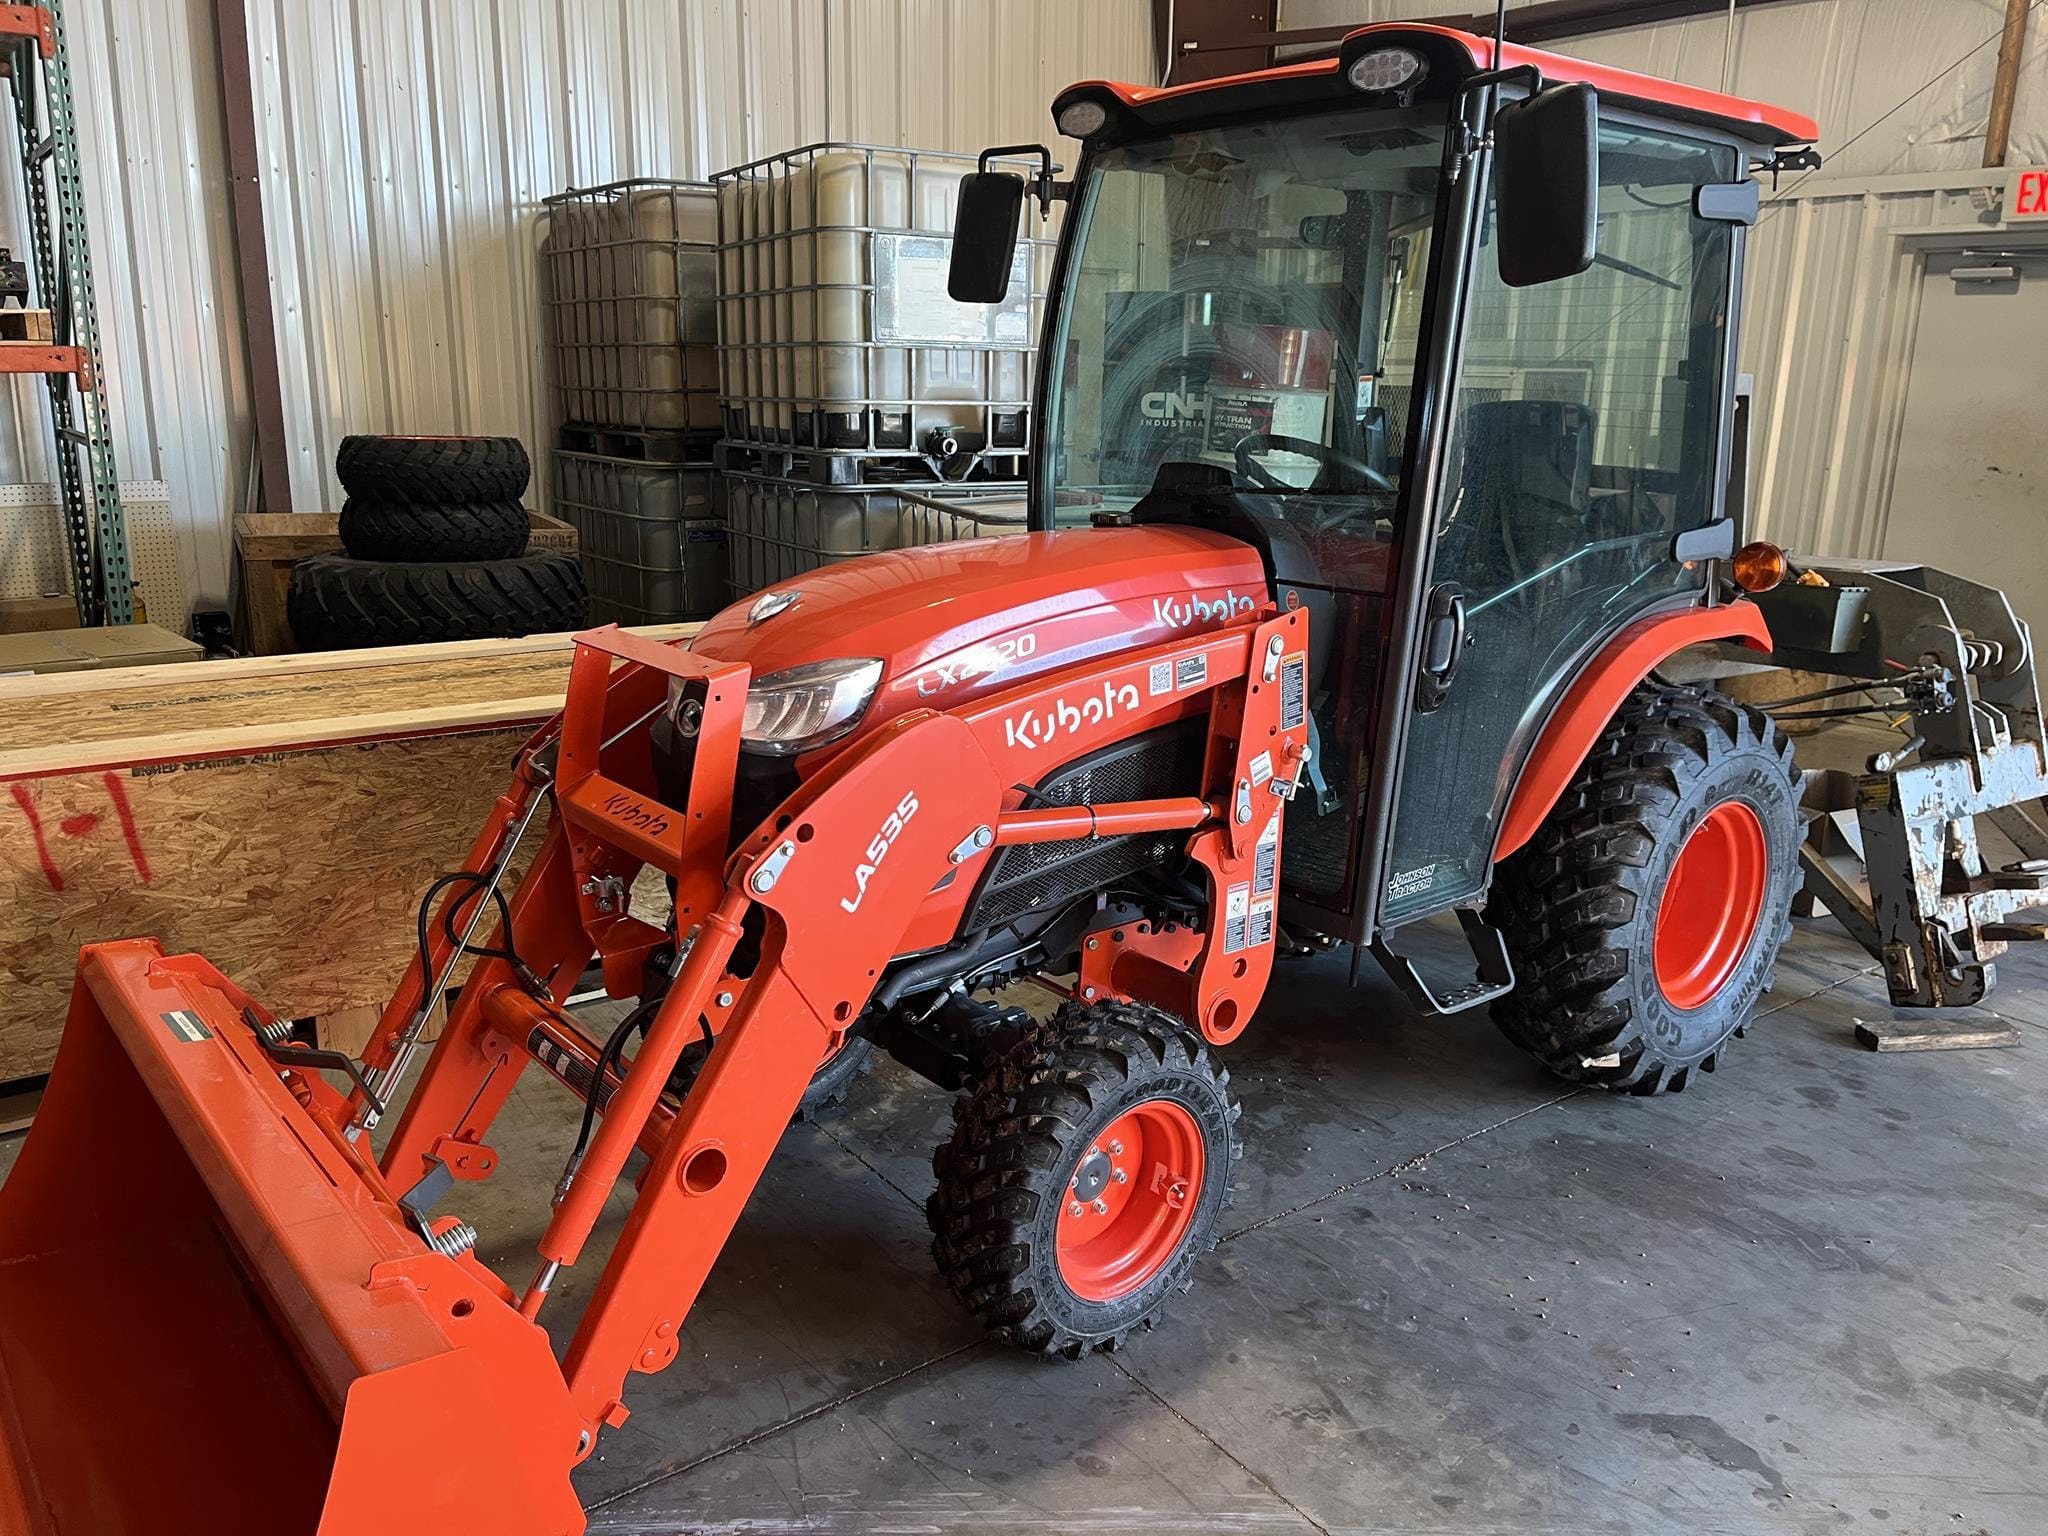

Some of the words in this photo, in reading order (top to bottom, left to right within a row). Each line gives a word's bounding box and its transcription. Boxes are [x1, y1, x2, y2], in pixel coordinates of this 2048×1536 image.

[1141, 391, 1207, 419] CNH
[1141, 419, 1204, 428] INDUSTRIA
[1153, 589, 1255, 629] Kubota
[917, 633, 1036, 699] LX220
[1005, 681, 1139, 749] Kubota
[603, 792, 669, 836] Kubota
[840, 789, 919, 913] LA535
[1388, 863, 1436, 890] JOHNSON
[1388, 877, 1433, 902] TRACTOR
[1119, 1077, 1225, 1147] GOODYEAR
